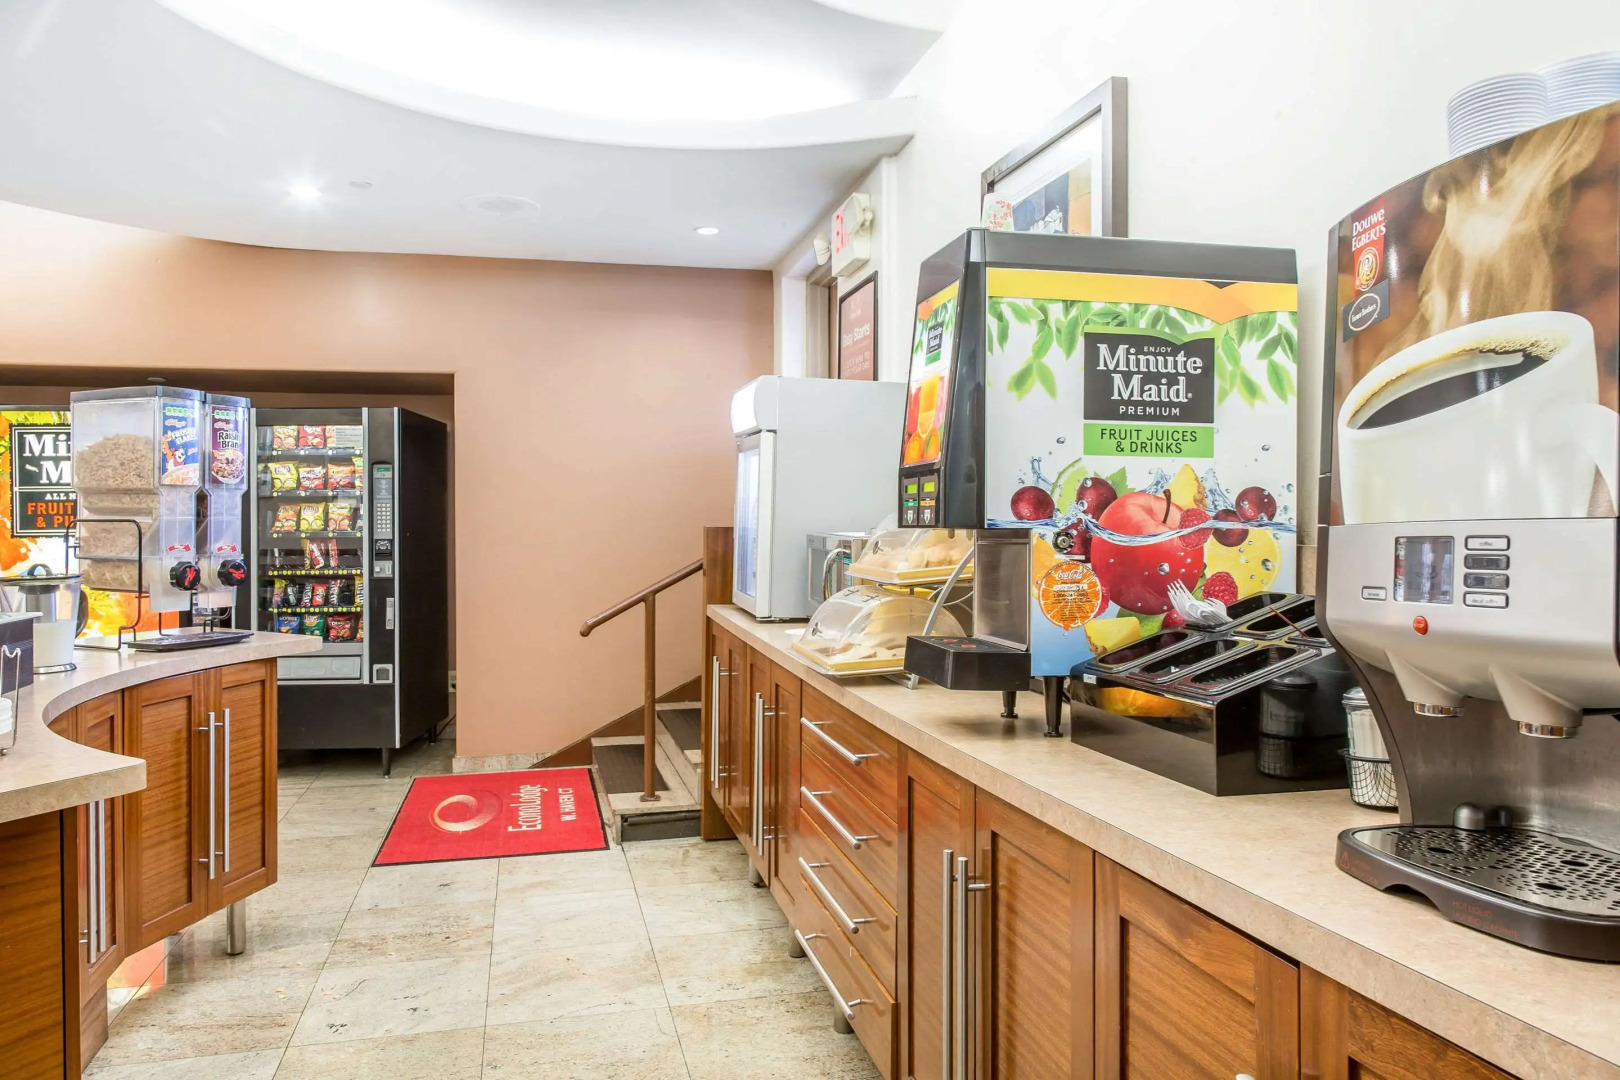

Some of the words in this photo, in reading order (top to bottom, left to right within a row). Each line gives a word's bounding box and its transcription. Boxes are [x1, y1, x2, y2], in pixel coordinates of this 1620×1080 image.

[1352, 223, 1386, 251] EGBERTS
[1096, 343, 1203, 375] Minute
[1110, 373, 1189, 403] Maid
[1119, 406, 1180, 416] PREMIUM
[218, 430, 241, 441] Raisin
[1100, 428, 1142, 441] FRUIT
[1146, 429, 1198, 443] JUICES
[23, 434, 71, 457] Mi
[221, 440, 239, 449] Bran
[1115, 440, 1125, 453] &
[1129, 441, 1183, 454] DRINKS
[27, 502, 74, 515] FRUIT
[36, 516, 46, 528] &
[559, 794, 576, 813] HAVEN
